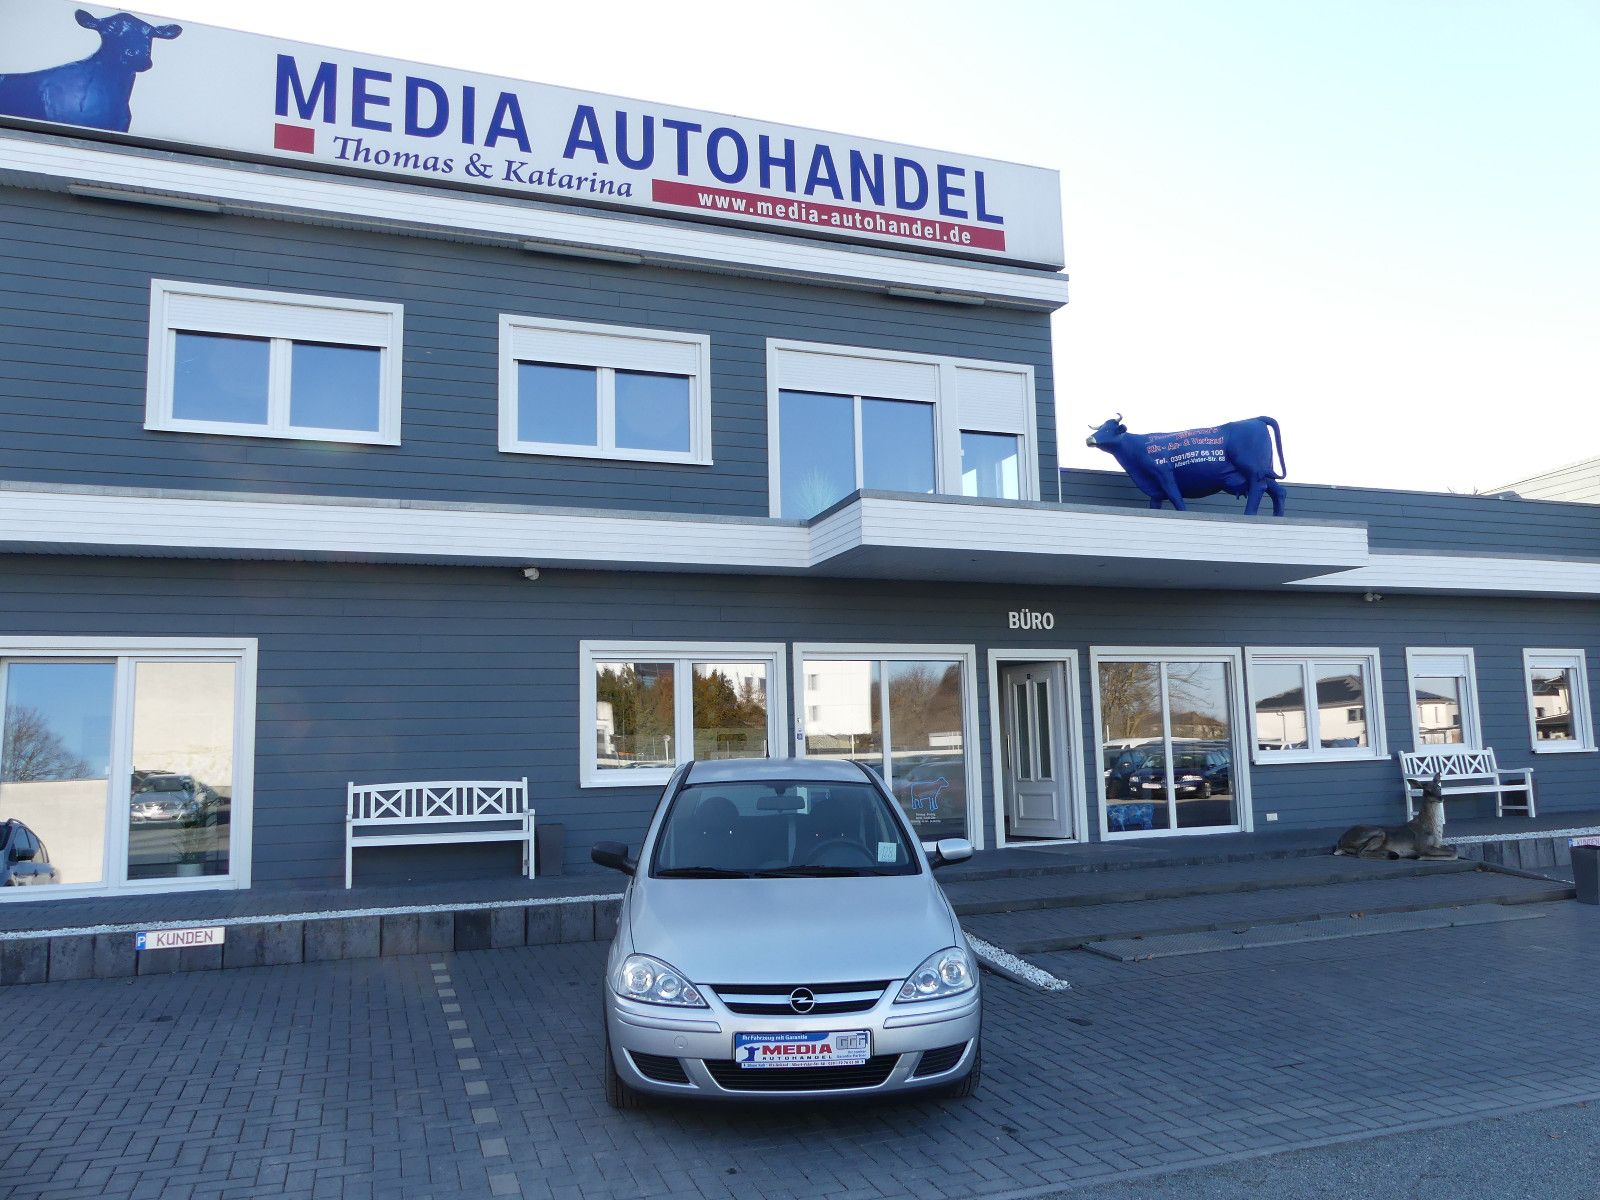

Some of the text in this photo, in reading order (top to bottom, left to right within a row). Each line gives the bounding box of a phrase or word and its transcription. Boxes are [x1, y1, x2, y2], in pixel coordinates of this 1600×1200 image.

[274, 53, 1004, 225] MEDIA AUTOHANDEL
[332, 135, 633, 198] Thomas & Katarina
[697, 190, 972, 245] www.media-autohandel.de
[1155, 457, 1168, 465] Tel.
[1008, 608, 1054, 630] BÜRO
[137, 930, 213, 947] P KUNDEN
[750, 1034, 775, 1042] Fahrzeug
[762, 1044, 832, 1055] MEDIA
